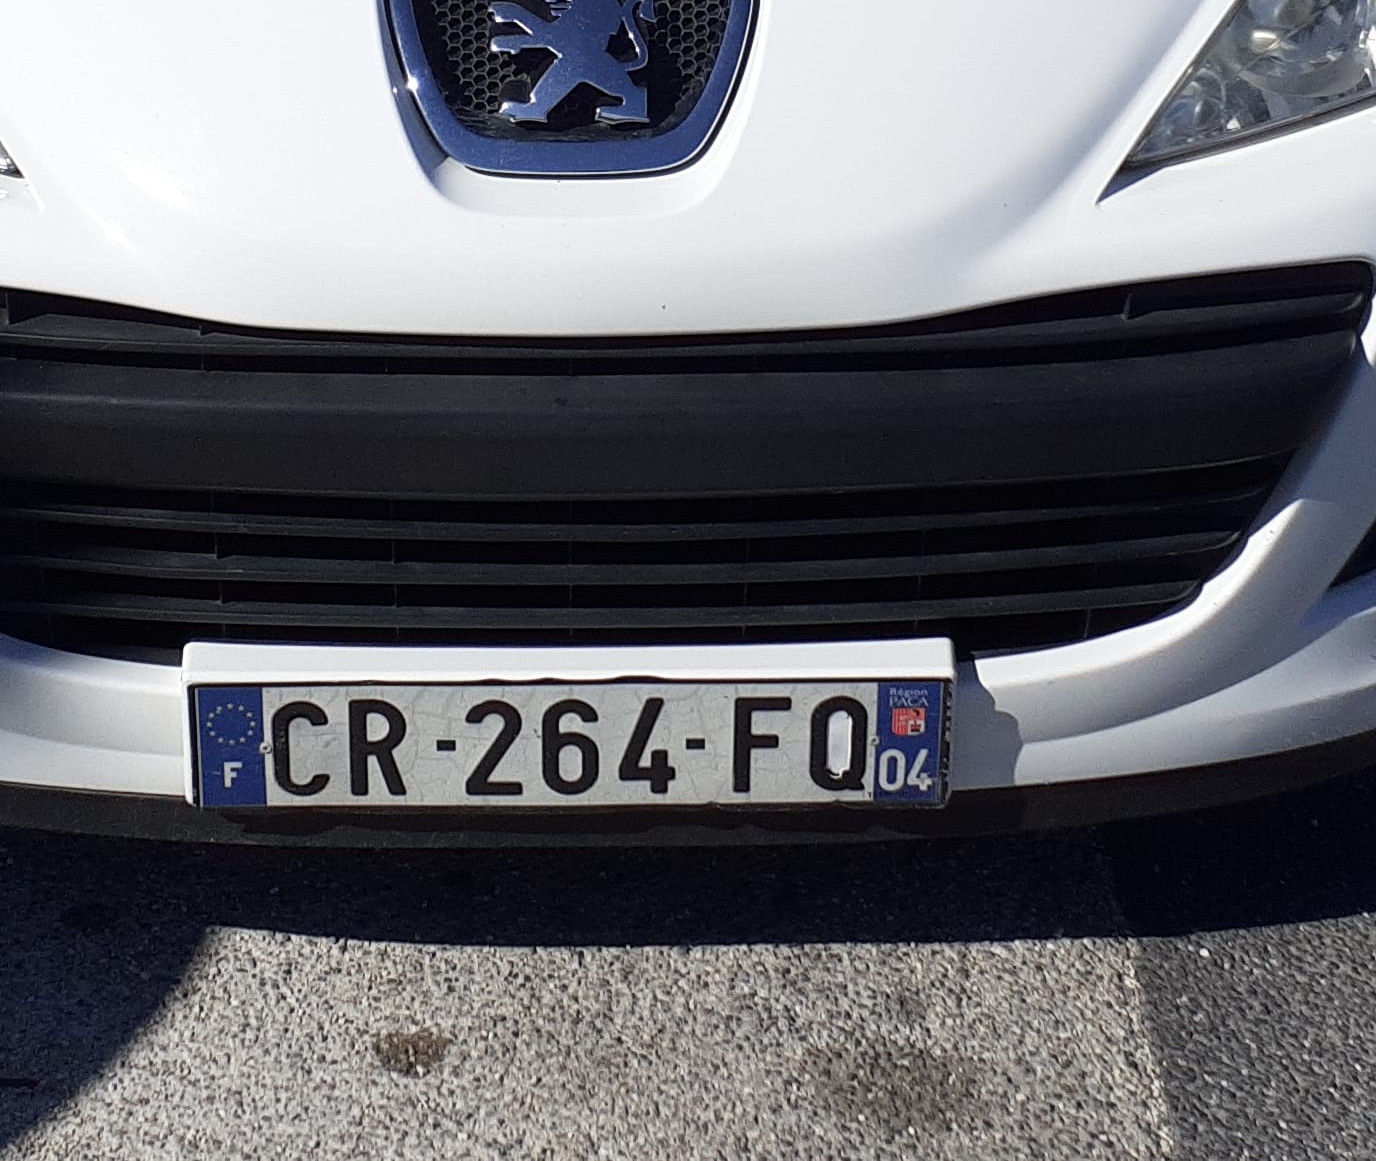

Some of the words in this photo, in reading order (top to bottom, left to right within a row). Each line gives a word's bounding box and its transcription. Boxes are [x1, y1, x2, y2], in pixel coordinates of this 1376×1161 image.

[889, 687, 929, 699] Région
[889, 697, 929, 707] PACA
[271, 694, 866, 796] CR-264-FQ
[224, 762, 243, 788] F
[878, 748, 932, 791] 04
